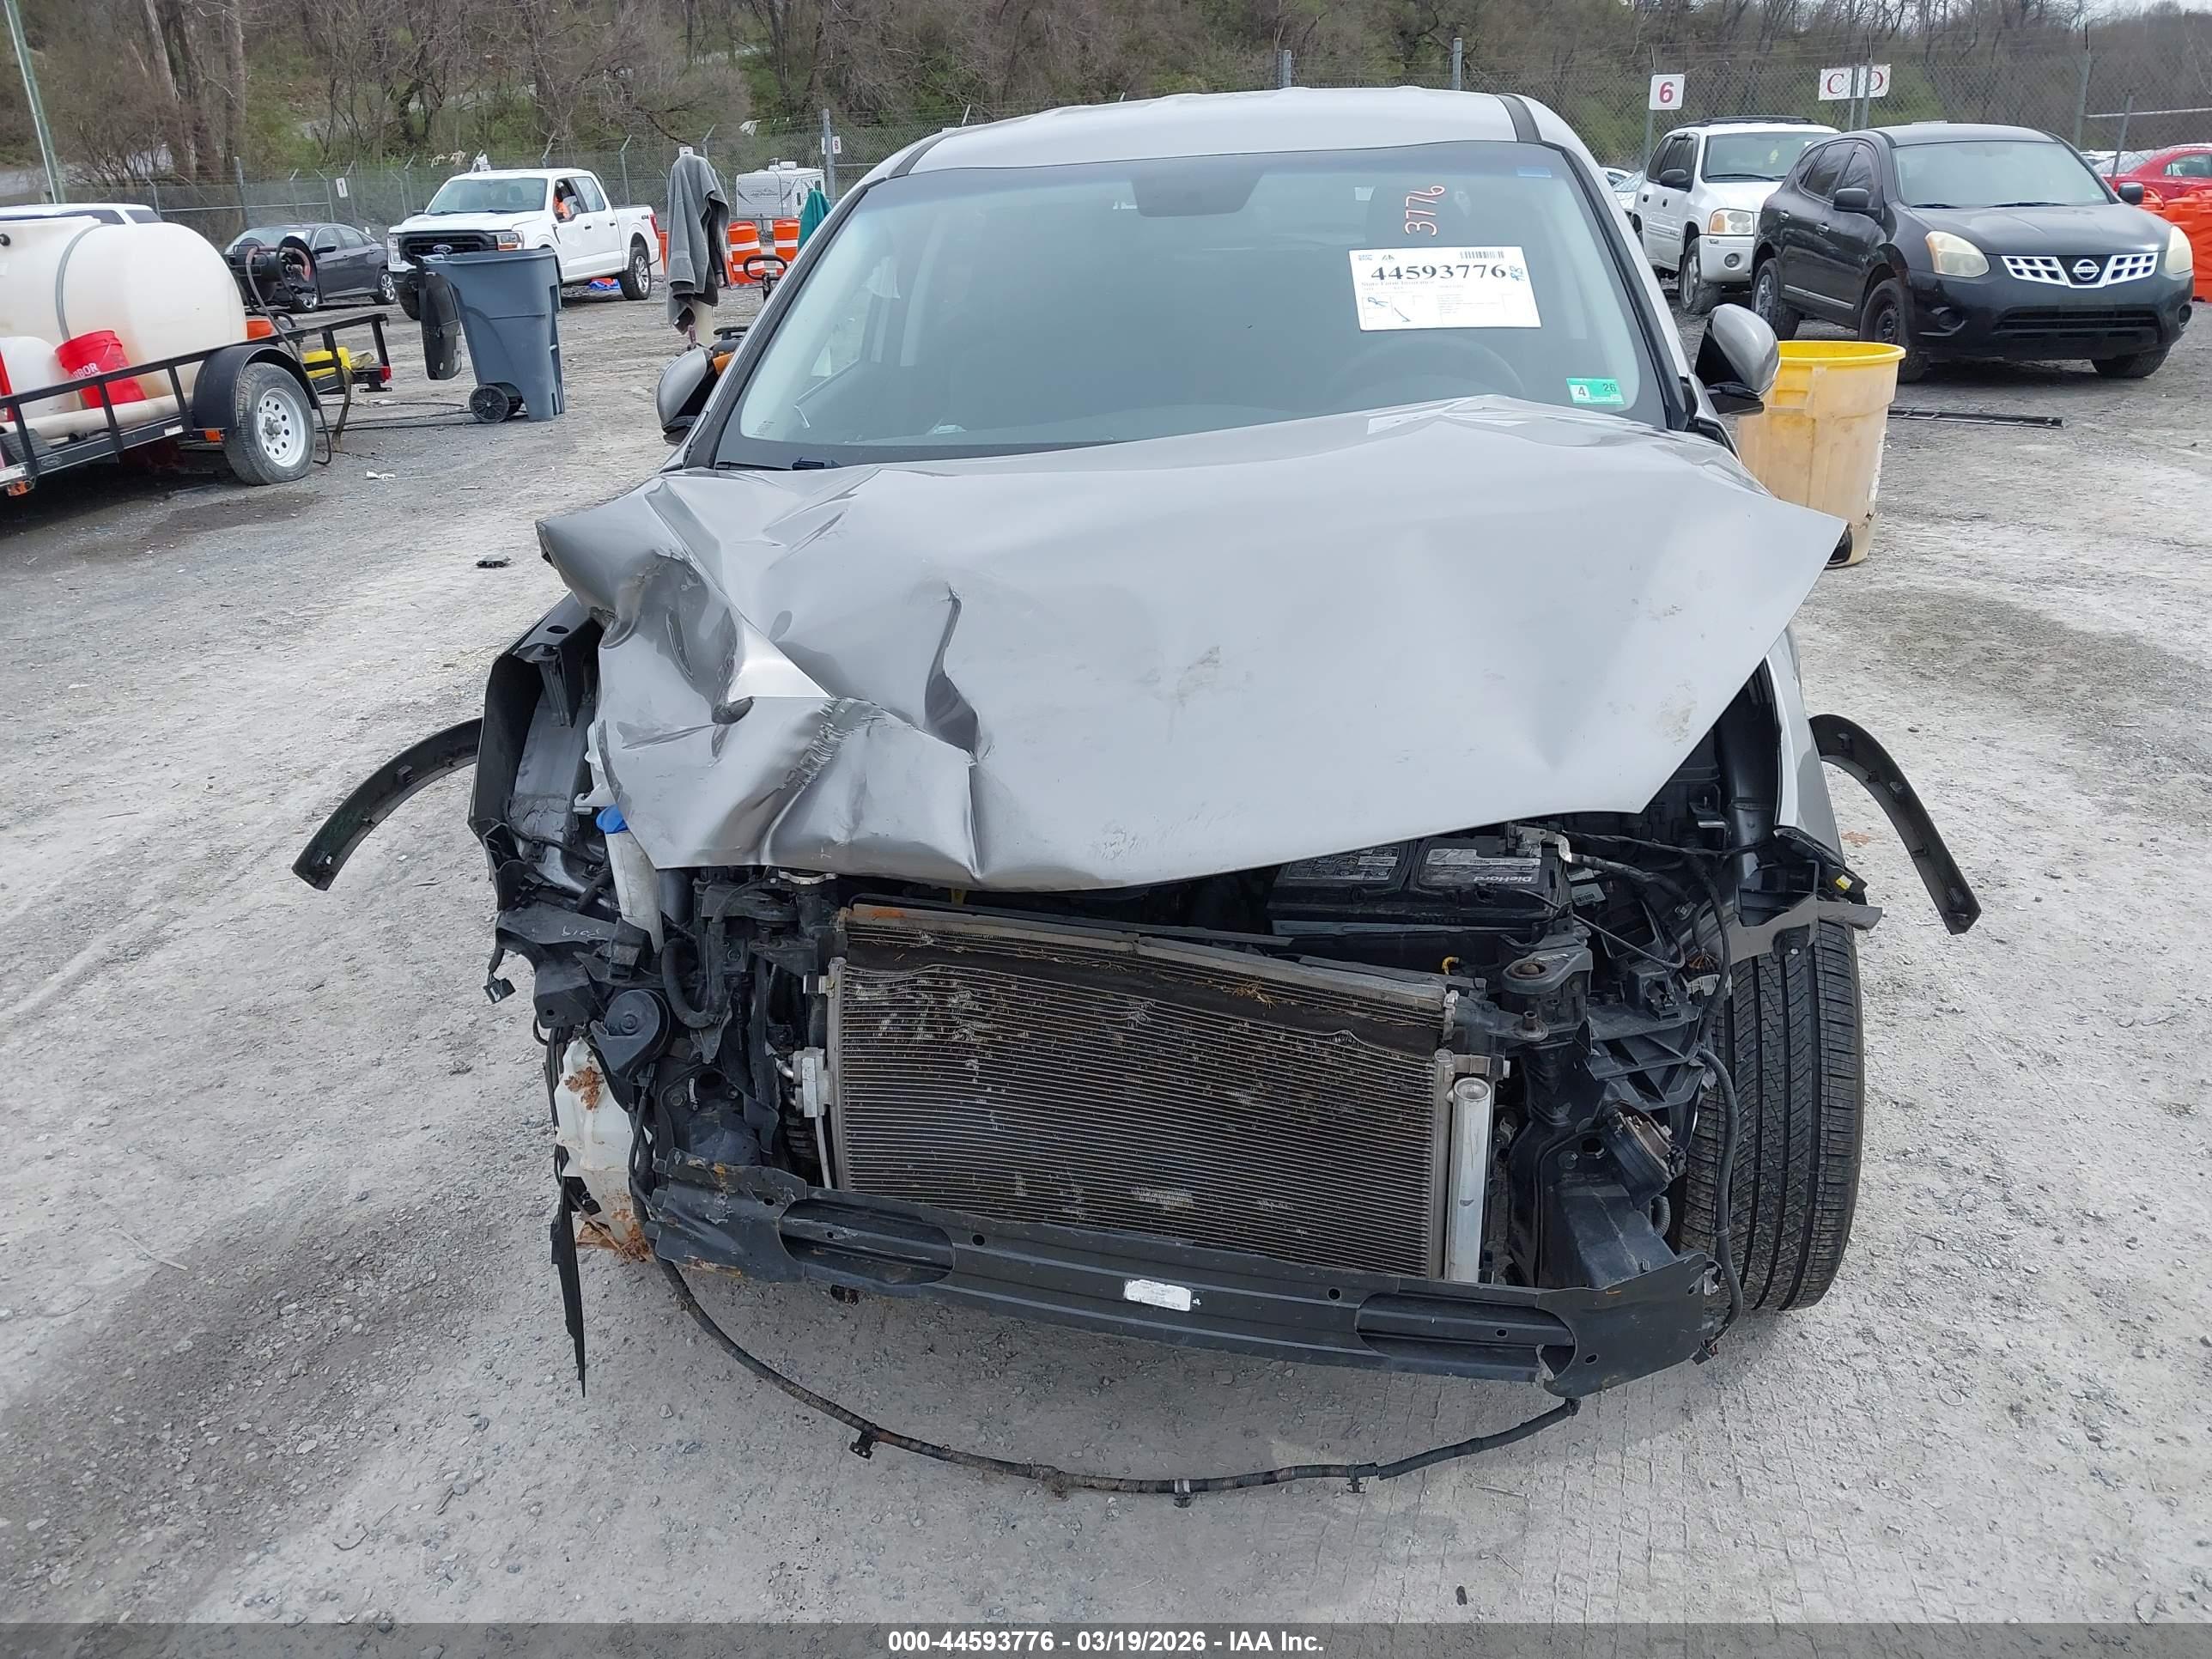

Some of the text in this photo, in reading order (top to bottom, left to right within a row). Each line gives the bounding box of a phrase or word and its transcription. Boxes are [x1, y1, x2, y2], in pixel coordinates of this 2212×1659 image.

[1658, 81, 1674, 103] 6
[1826, 73, 1844, 94] C
[1404, 185, 1445, 235] 3776
[1370, 264, 1506, 281] 44593776
[1577, 386, 1587, 397] 4
[1602, 383, 1617, 392] 26
